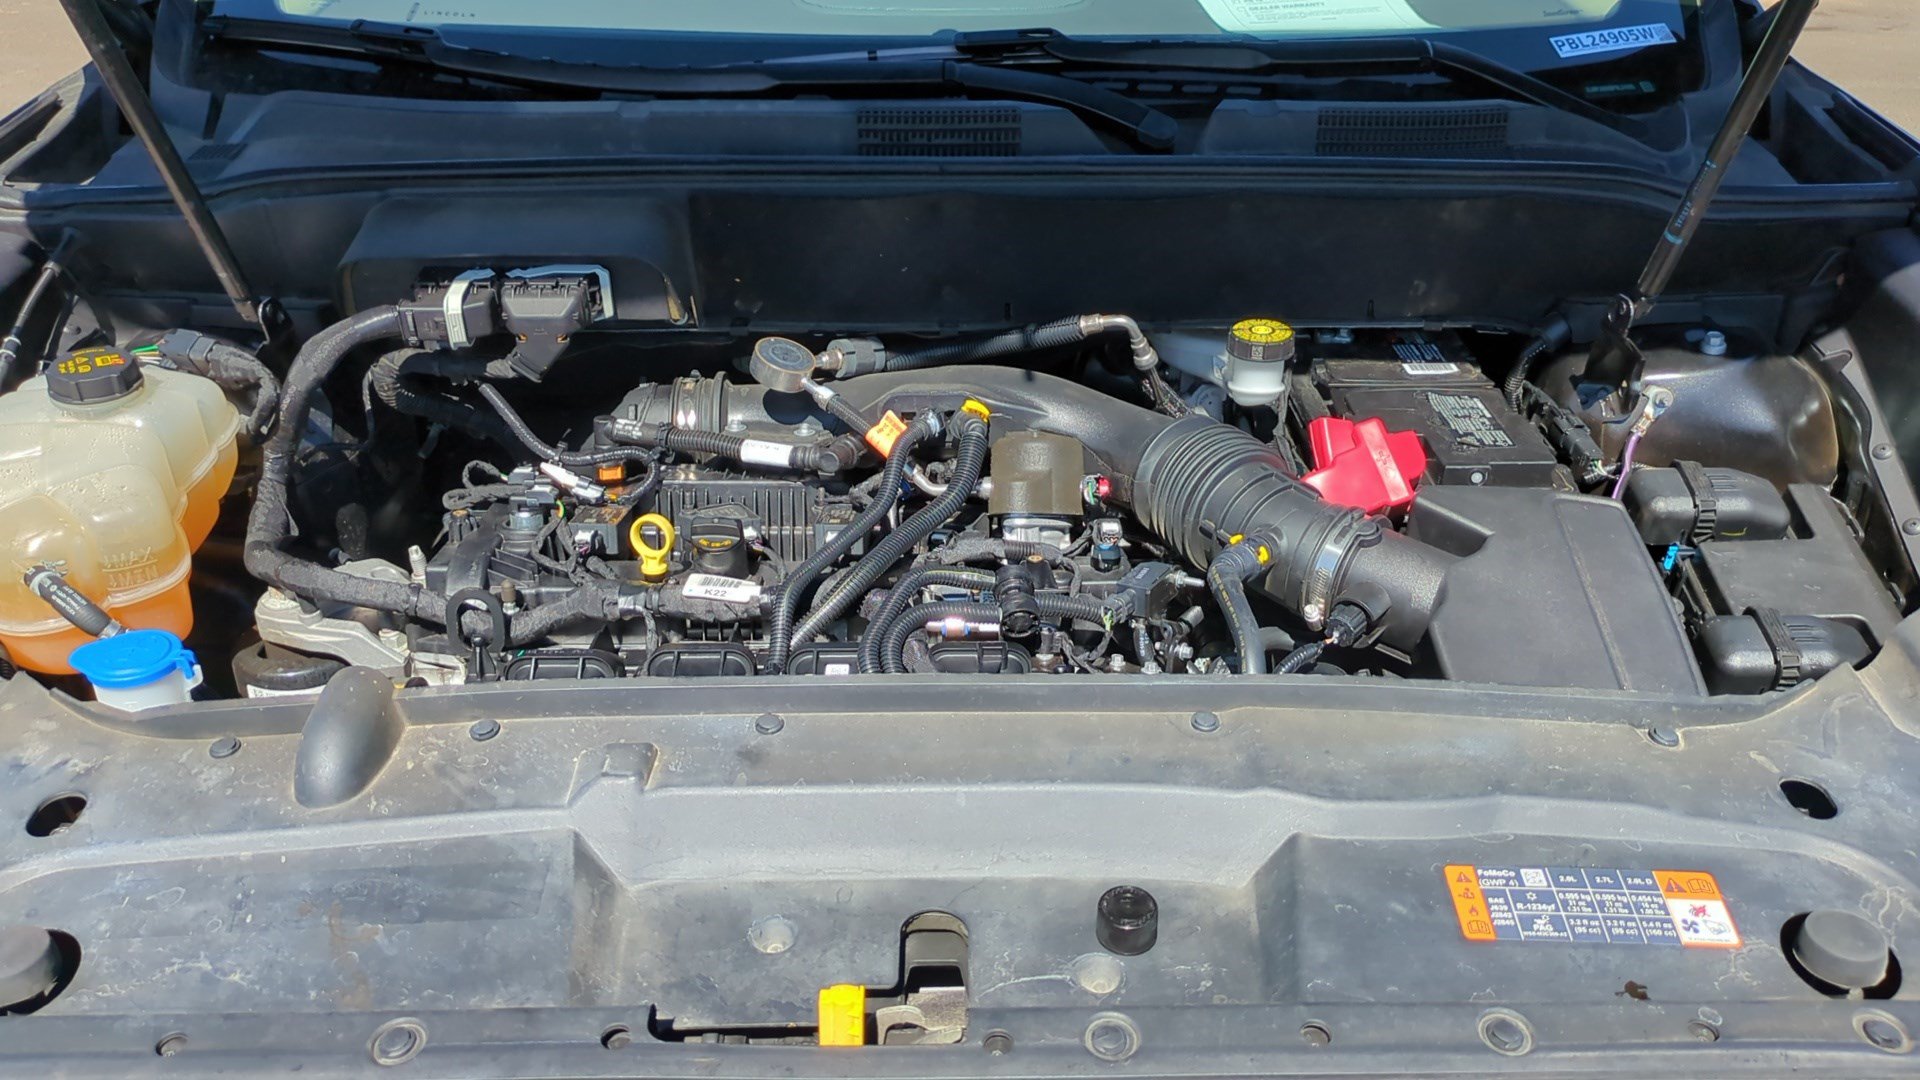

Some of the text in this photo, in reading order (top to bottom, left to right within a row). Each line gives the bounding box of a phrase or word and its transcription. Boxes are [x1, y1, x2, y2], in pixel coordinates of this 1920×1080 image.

[1554, 26, 1655, 51] PBL24905W
[704, 589, 728, 597] K22
[1477, 869, 1516, 877] FoMoCo
[1479, 879, 1506, 888] (GWP
